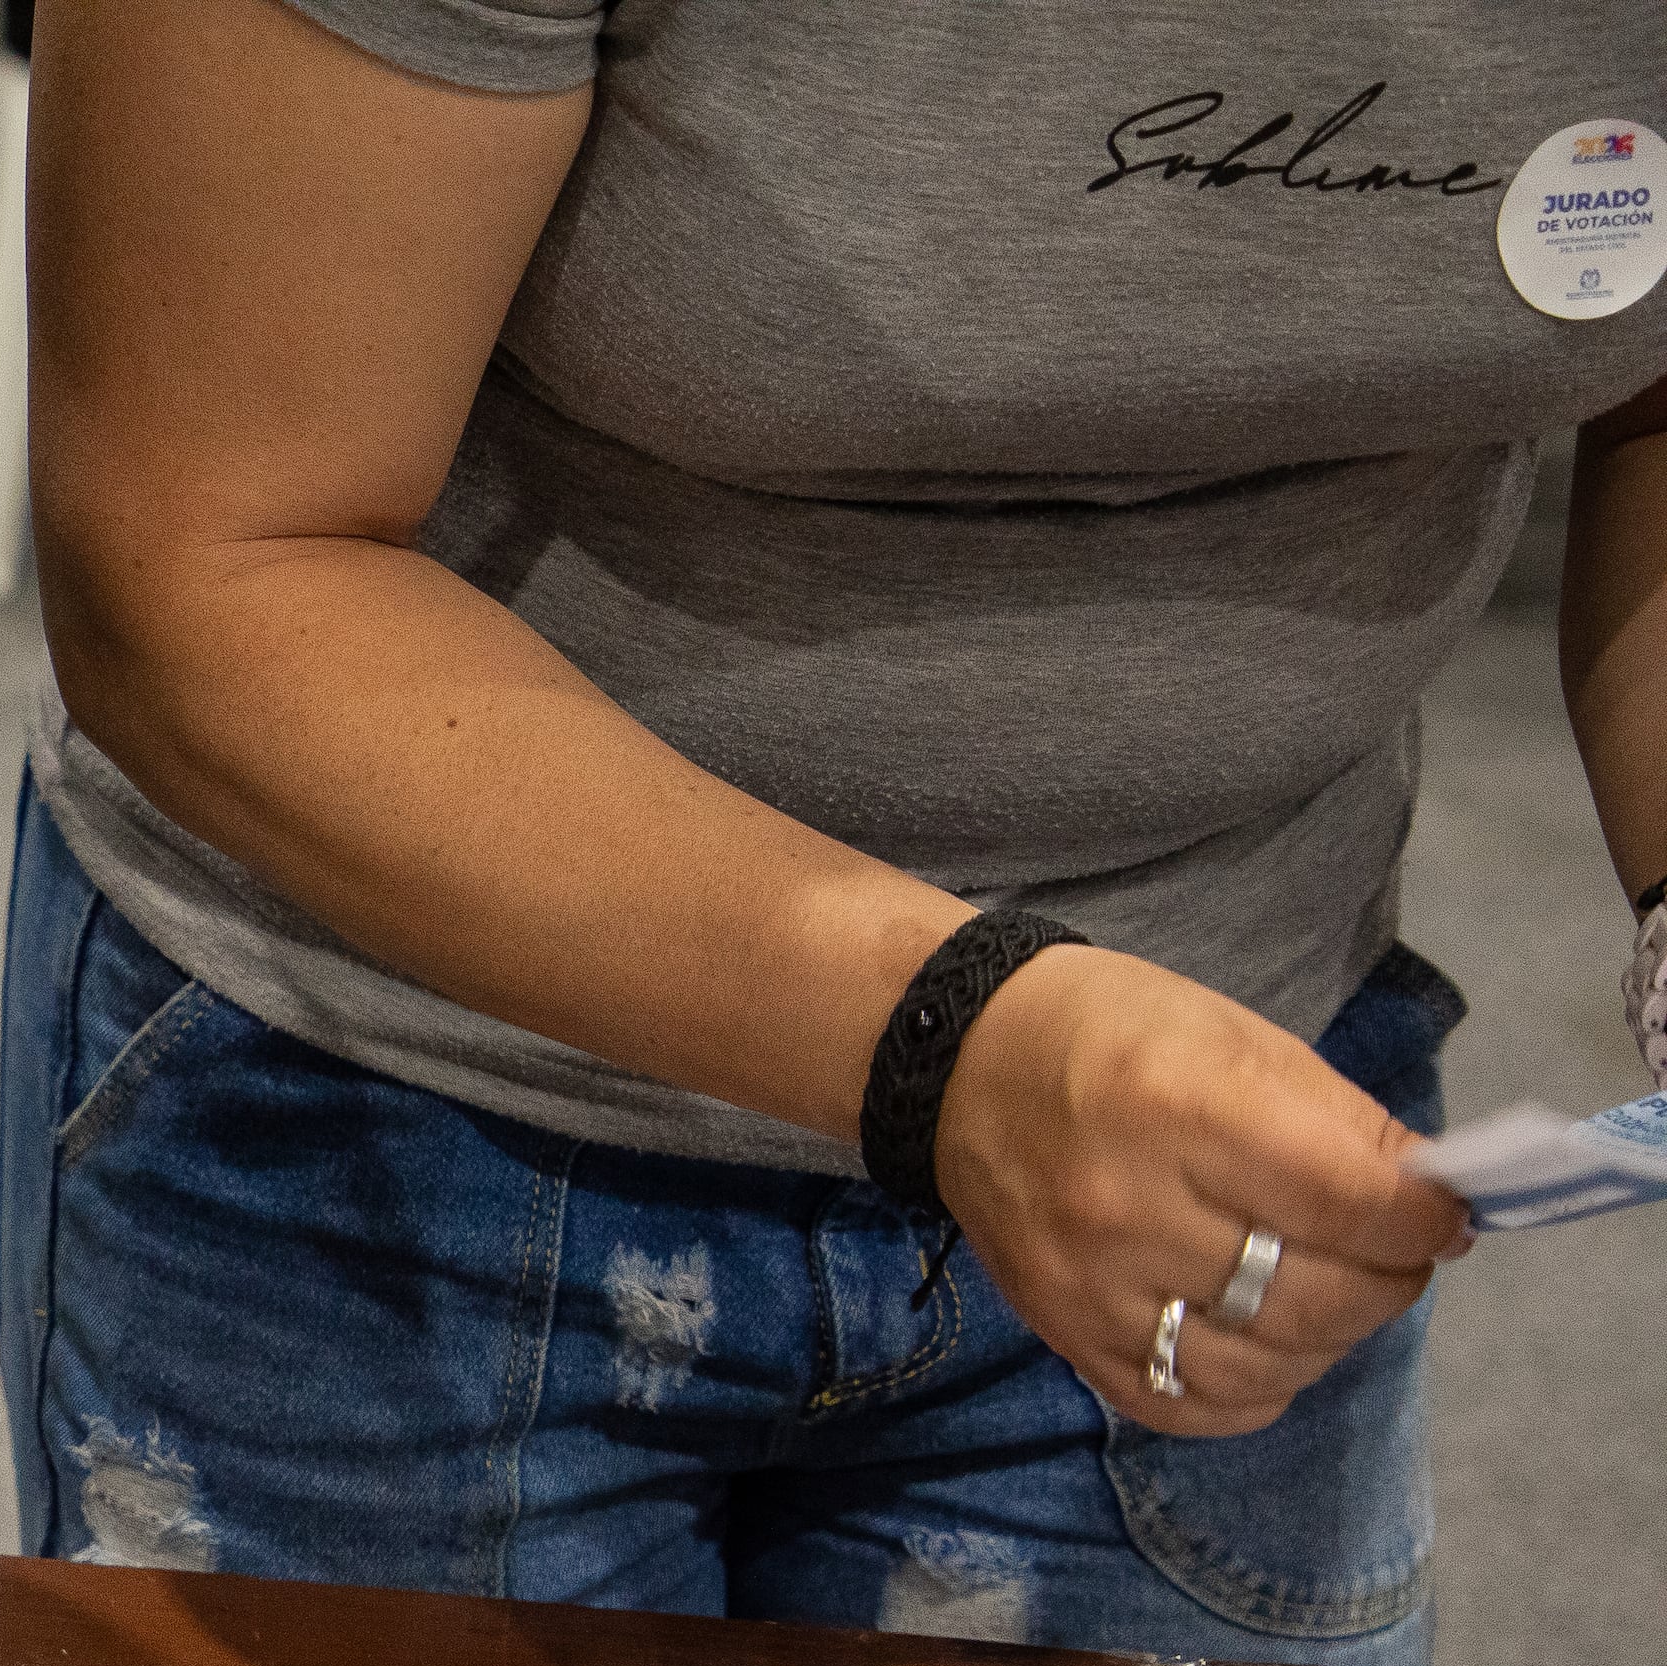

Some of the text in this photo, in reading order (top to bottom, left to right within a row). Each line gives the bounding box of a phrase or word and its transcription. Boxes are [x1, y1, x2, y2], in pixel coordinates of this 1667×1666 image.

[1087, 81, 1501, 195] Sublime
[1543, 187, 1650, 214] JURADO
[1537, 209, 1653, 233] DE VOTACIÓN
